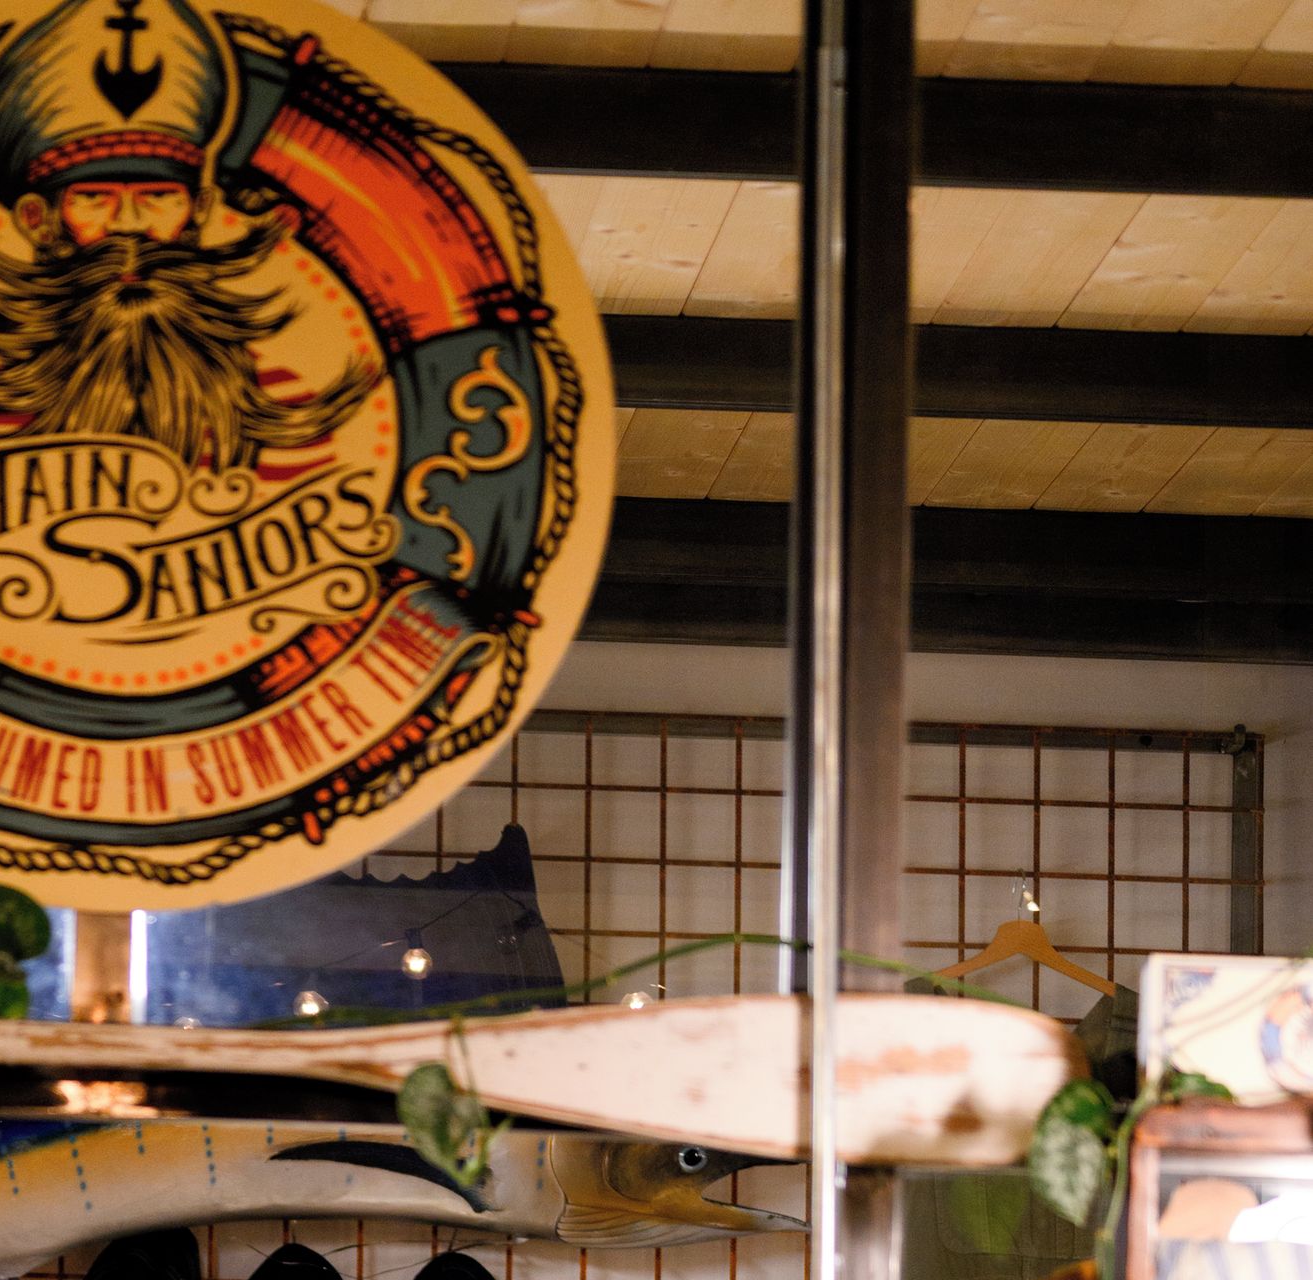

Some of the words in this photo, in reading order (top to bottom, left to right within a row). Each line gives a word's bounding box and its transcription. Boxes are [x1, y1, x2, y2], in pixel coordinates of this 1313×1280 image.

[44, 466, 400, 625] SANTORS
[125, 746, 170, 814] IN
[185, 680, 374, 806] SUMMER
[349, 593, 462, 704] TIME
